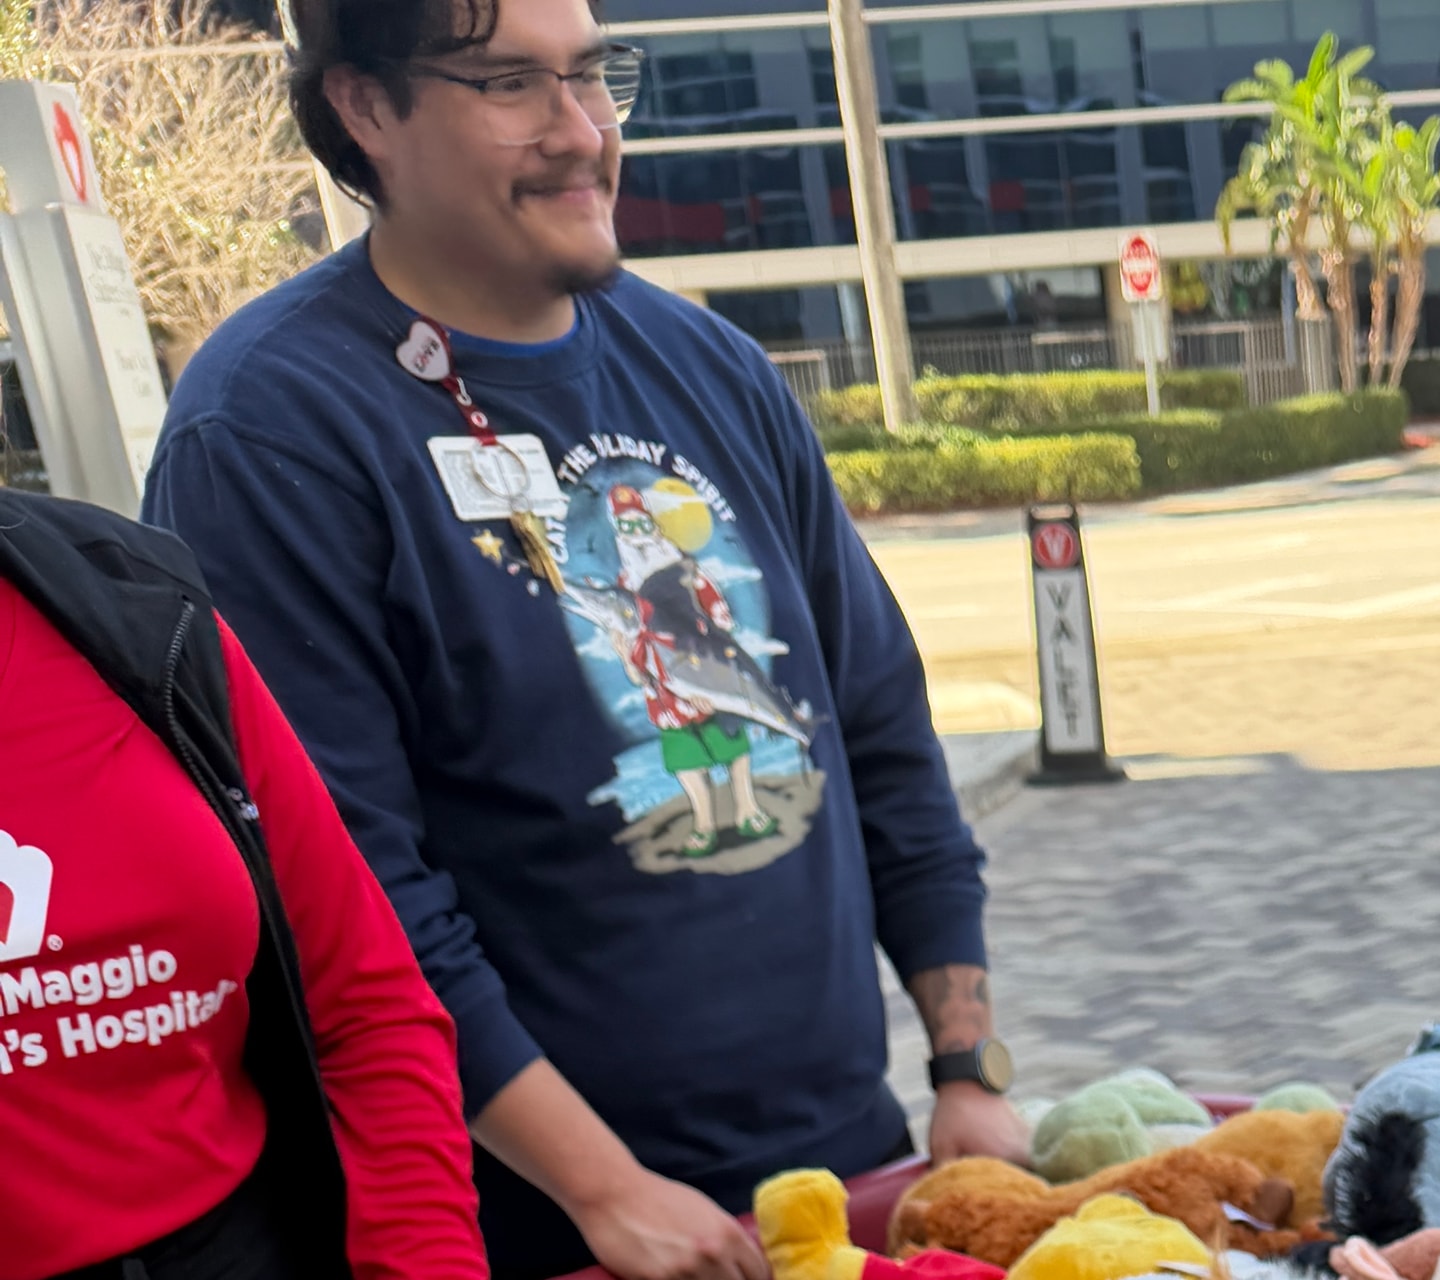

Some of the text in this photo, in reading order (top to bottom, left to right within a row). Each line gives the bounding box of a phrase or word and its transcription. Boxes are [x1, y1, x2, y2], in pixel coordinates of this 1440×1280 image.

[557, 443, 598, 486] THE
[589, 432, 667, 466] LIDAY
[671, 453, 737, 522] SPIRIT
[1046, 578, 1079, 738] VALET
[56, 978, 230, 1058] Hospital
